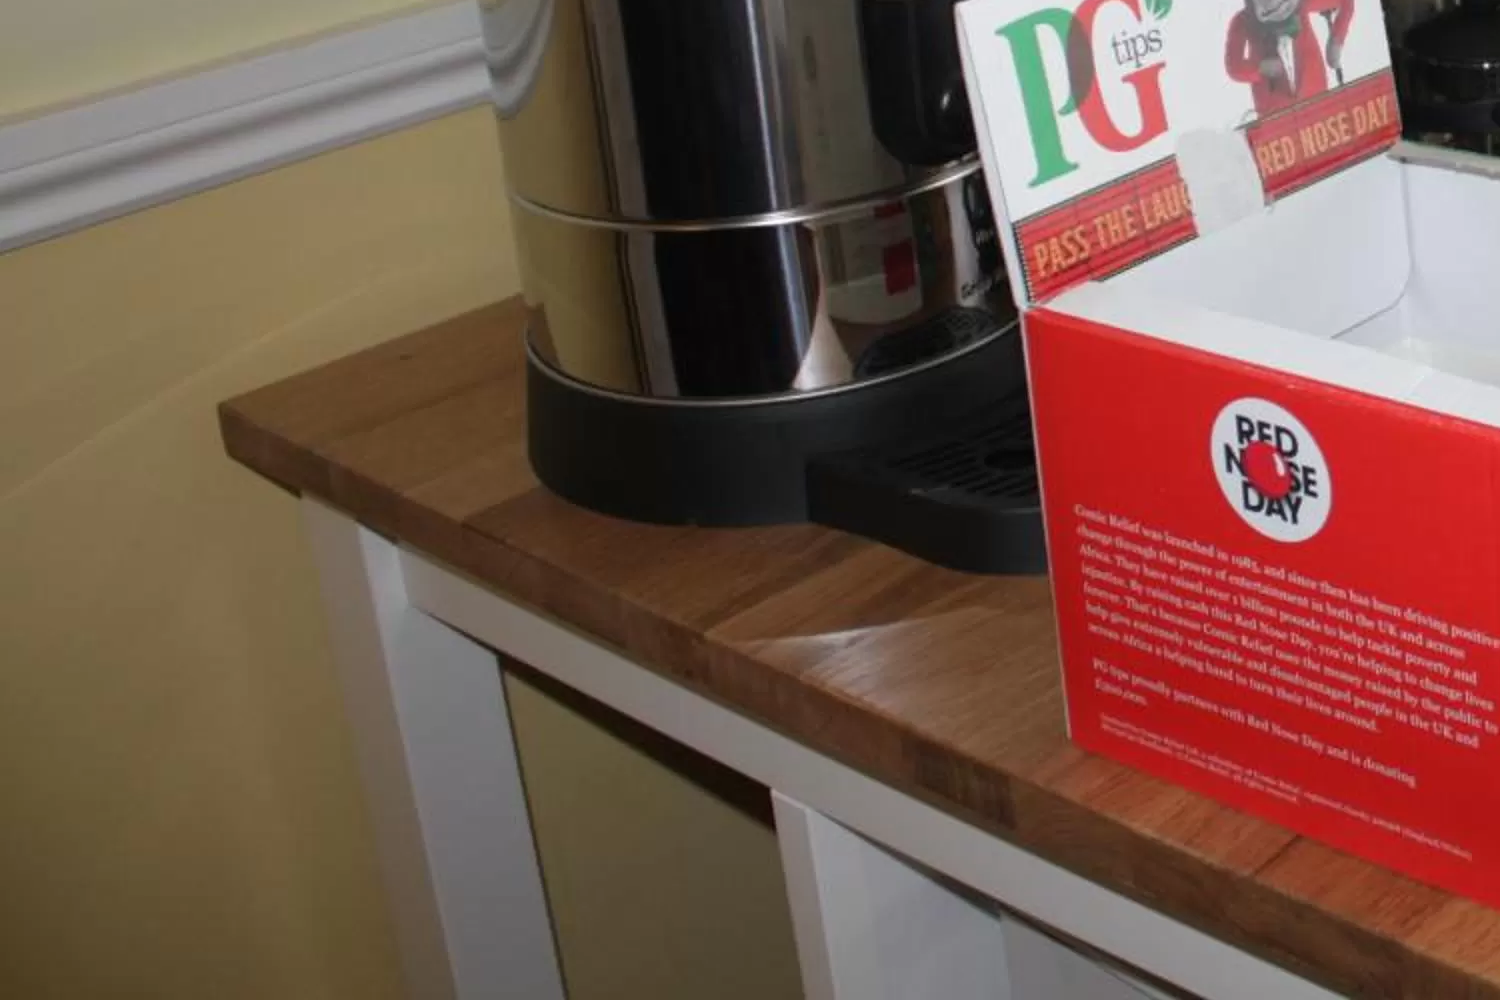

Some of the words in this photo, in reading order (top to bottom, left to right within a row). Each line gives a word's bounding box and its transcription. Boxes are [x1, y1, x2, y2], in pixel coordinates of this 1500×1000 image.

[1111, 24, 1163, 68] tips
[1257, 136, 1296, 178] RED
[1300, 112, 1351, 158] NOSE
[1352, 95, 1389, 135] DAY
[1033, 229, 1092, 278] PASS
[1096, 207, 1138, 253] THE
[1235, 414, 1298, 458] RED
[1242, 482, 1303, 525] DAY
[1228, 575, 1308, 608] entertainment
[1312, 600, 1321, 612] in
[1326, 604, 1352, 622] both
[1356, 614, 1374, 630] the
[1378, 622, 1397, 637] UK
[1400, 632, 1422, 646] and
[1426, 640, 1465, 660] across
[1264, 565, 1284, 579] and
[1288, 572, 1316, 589] since
[1321, 581, 1345, 598] then
[1350, 590, 1367, 606] has
[1372, 598, 1400, 616] been
[1405, 608, 1448, 634] driving
[1451, 626, 1499, 648] positive
[1204, 623, 1237, 644] Comic
[1241, 636, 1273, 656] Relief
[1303, 657, 1320, 673] the
[1365, 681, 1400, 701] raised
[1404, 693, 1418, 710] by
[1421, 699, 1440, 715] the
[1444, 709, 1482, 729] public
[1485, 721, 1498, 735] to
[1235, 614, 1256, 630] Red
[1260, 622, 1287, 641] Nose
[1319, 645, 1354, 664] you're
[1357, 656, 1401, 683] helping
[1404, 672, 1416, 685] to
[1420, 680, 1462, 702] change
[1466, 693, 1494, 712] lives
[1324, 624, 1335, 637] to
[1339, 629, 1364, 649] help
[1367, 638, 1401, 659] tackle
[1406, 654, 1450, 678] poverty
[1453, 670, 1476, 684] and
[1306, 697, 1331, 715] lives
[1353, 697, 1392, 718] people
[1395, 710, 1406, 723] in
[1410, 715, 1428, 730] the
[1432, 723, 1453, 739] UK
[1456, 734, 1478, 748] and
[1248, 715, 1268, 731] Red
[1301, 735, 1324, 755] Day
[1326, 746, 1348, 761] and
[1351, 753, 1360, 765] is
[1363, 757, 1416, 789] donating
